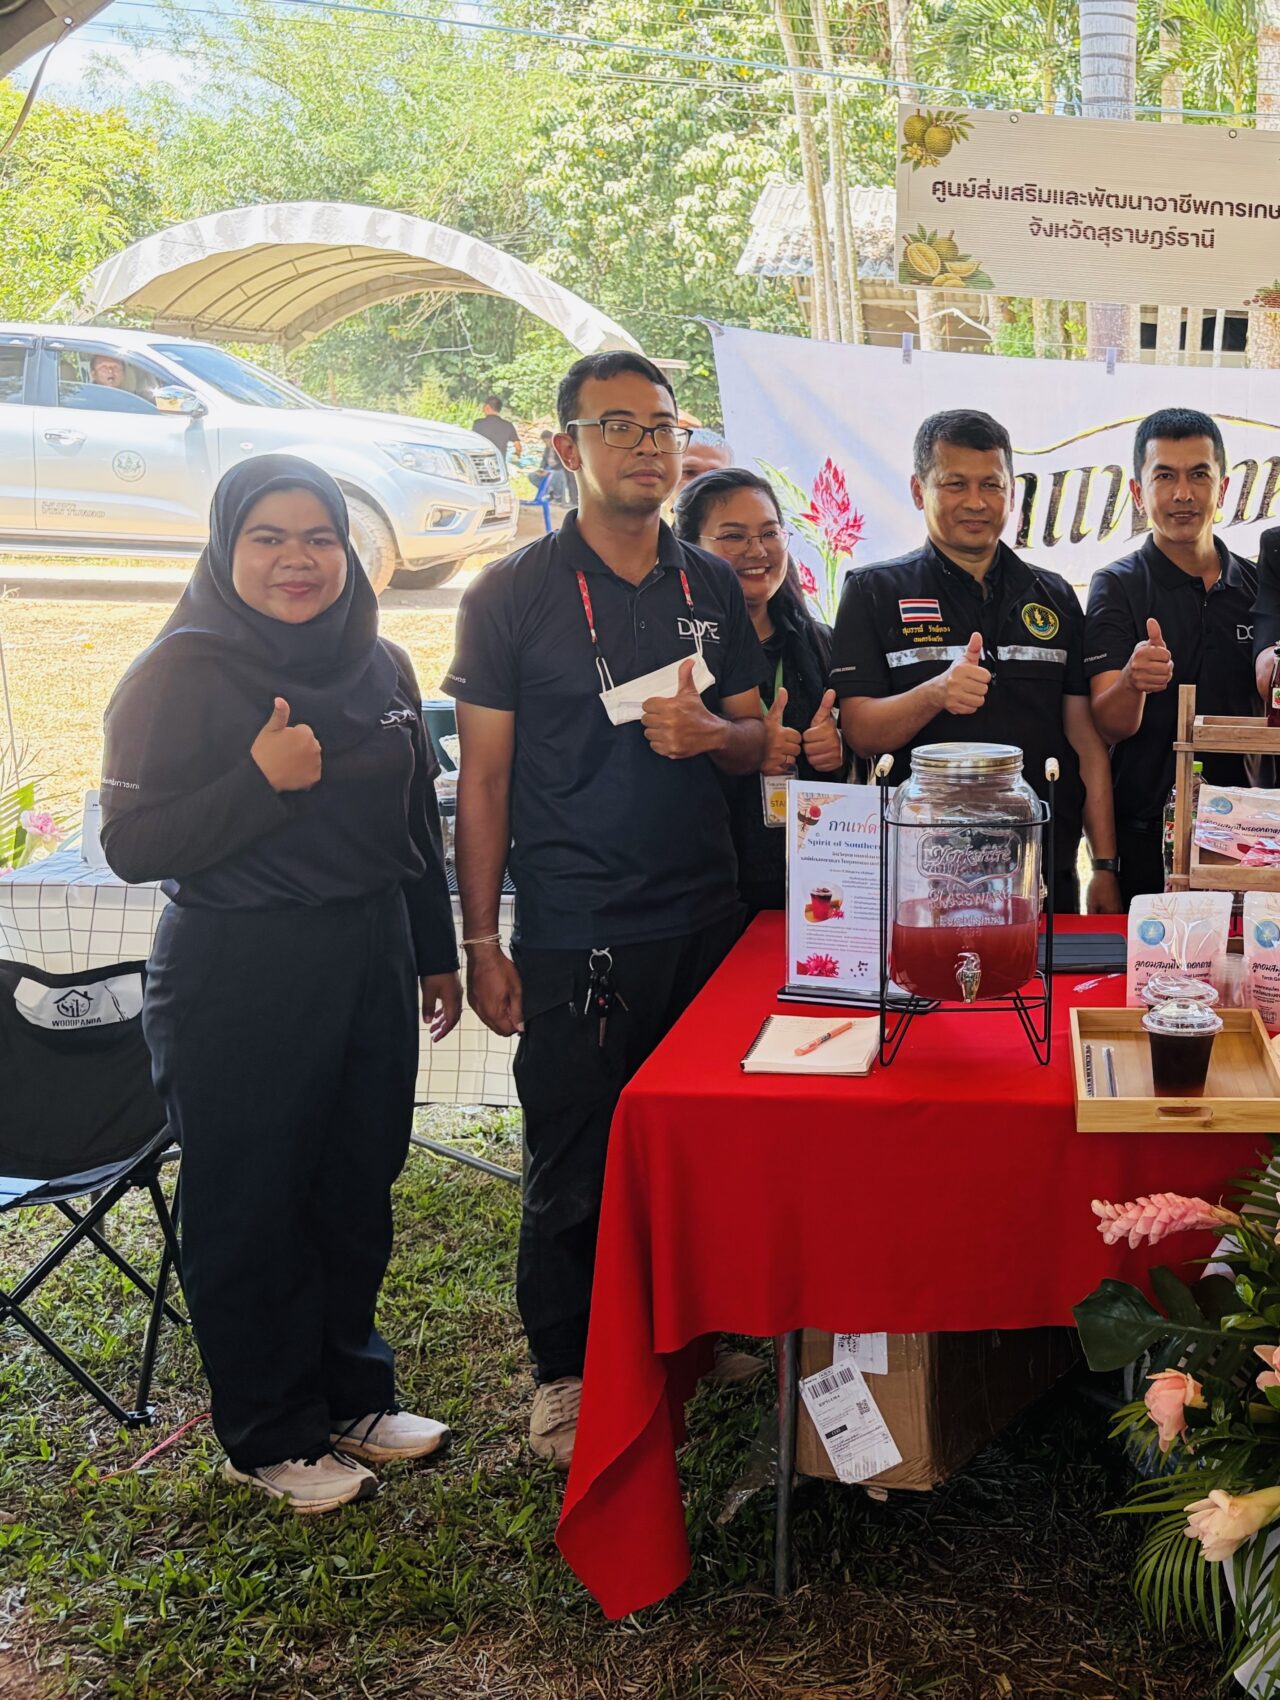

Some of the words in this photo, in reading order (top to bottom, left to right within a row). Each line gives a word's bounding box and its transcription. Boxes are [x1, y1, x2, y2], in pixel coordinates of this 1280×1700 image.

[1028, 216, 1216, 250] จังหวัดสุราษฎร์ธานี
[807, 838, 831, 847] Spirit
